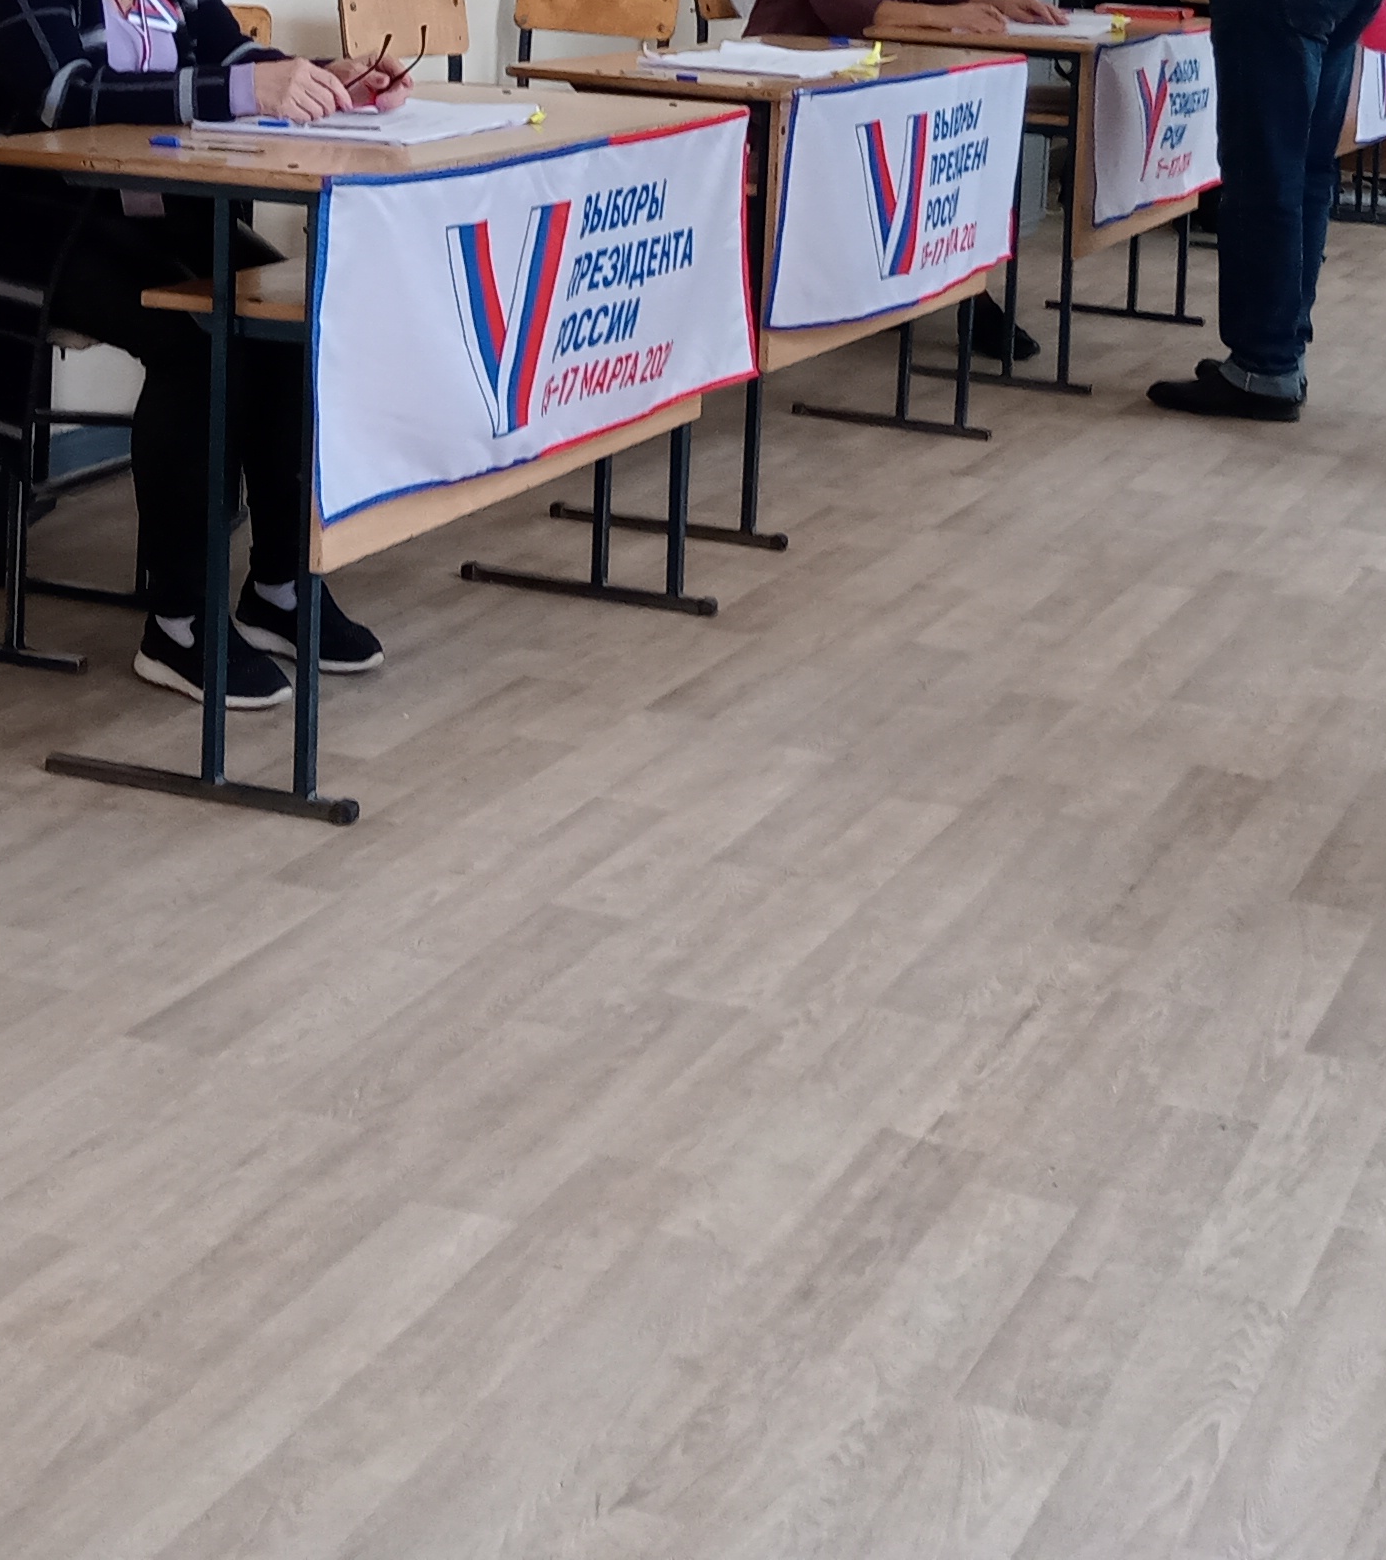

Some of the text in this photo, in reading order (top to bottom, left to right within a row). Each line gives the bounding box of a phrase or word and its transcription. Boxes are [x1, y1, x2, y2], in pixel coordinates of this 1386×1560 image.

[579, 177, 668, 240] ВЫБОРЫ
[566, 225, 694, 301] ПРЕЗИДЕНТА
[578, 349, 641, 402] МАРТА
[638, 338, 675, 384] 202
